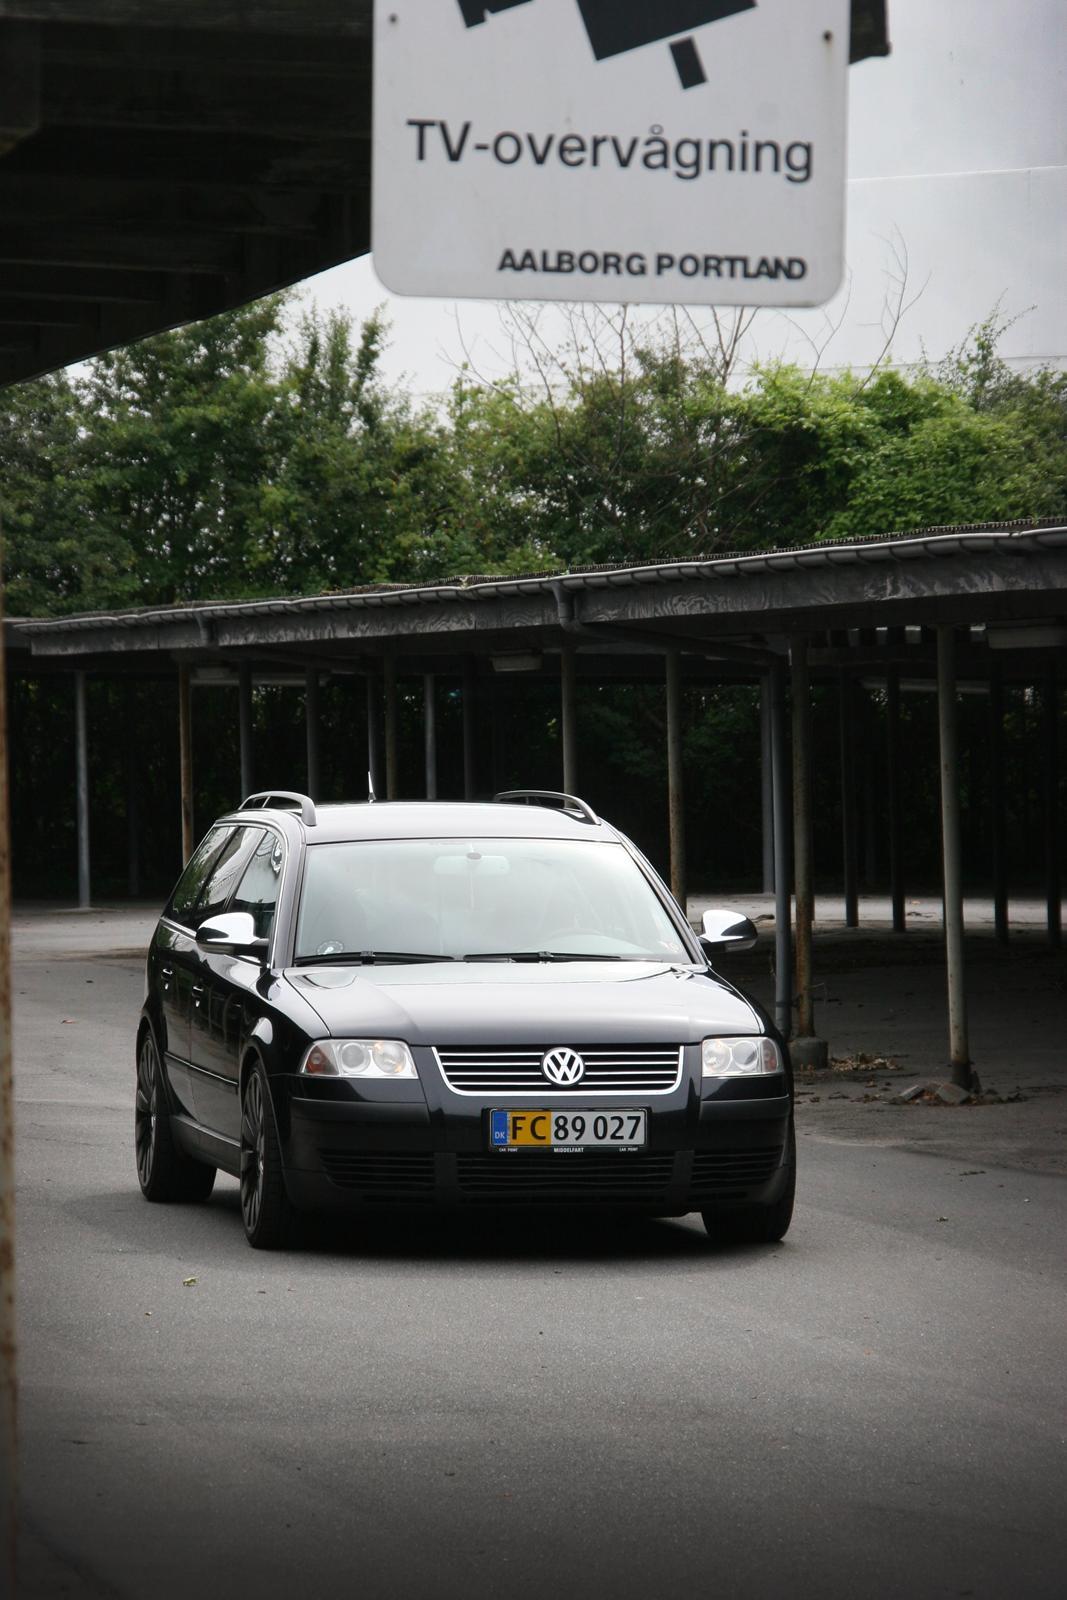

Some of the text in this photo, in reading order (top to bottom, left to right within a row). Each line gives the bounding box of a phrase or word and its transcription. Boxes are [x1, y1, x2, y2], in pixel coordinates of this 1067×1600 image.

[406, 119, 814, 183] TV-overvågning
[497, 249, 808, 281] AALBORG PORTLAND
[494, 1131, 506, 1140] DK
[511, 1115, 641, 1141] FC 89 027
